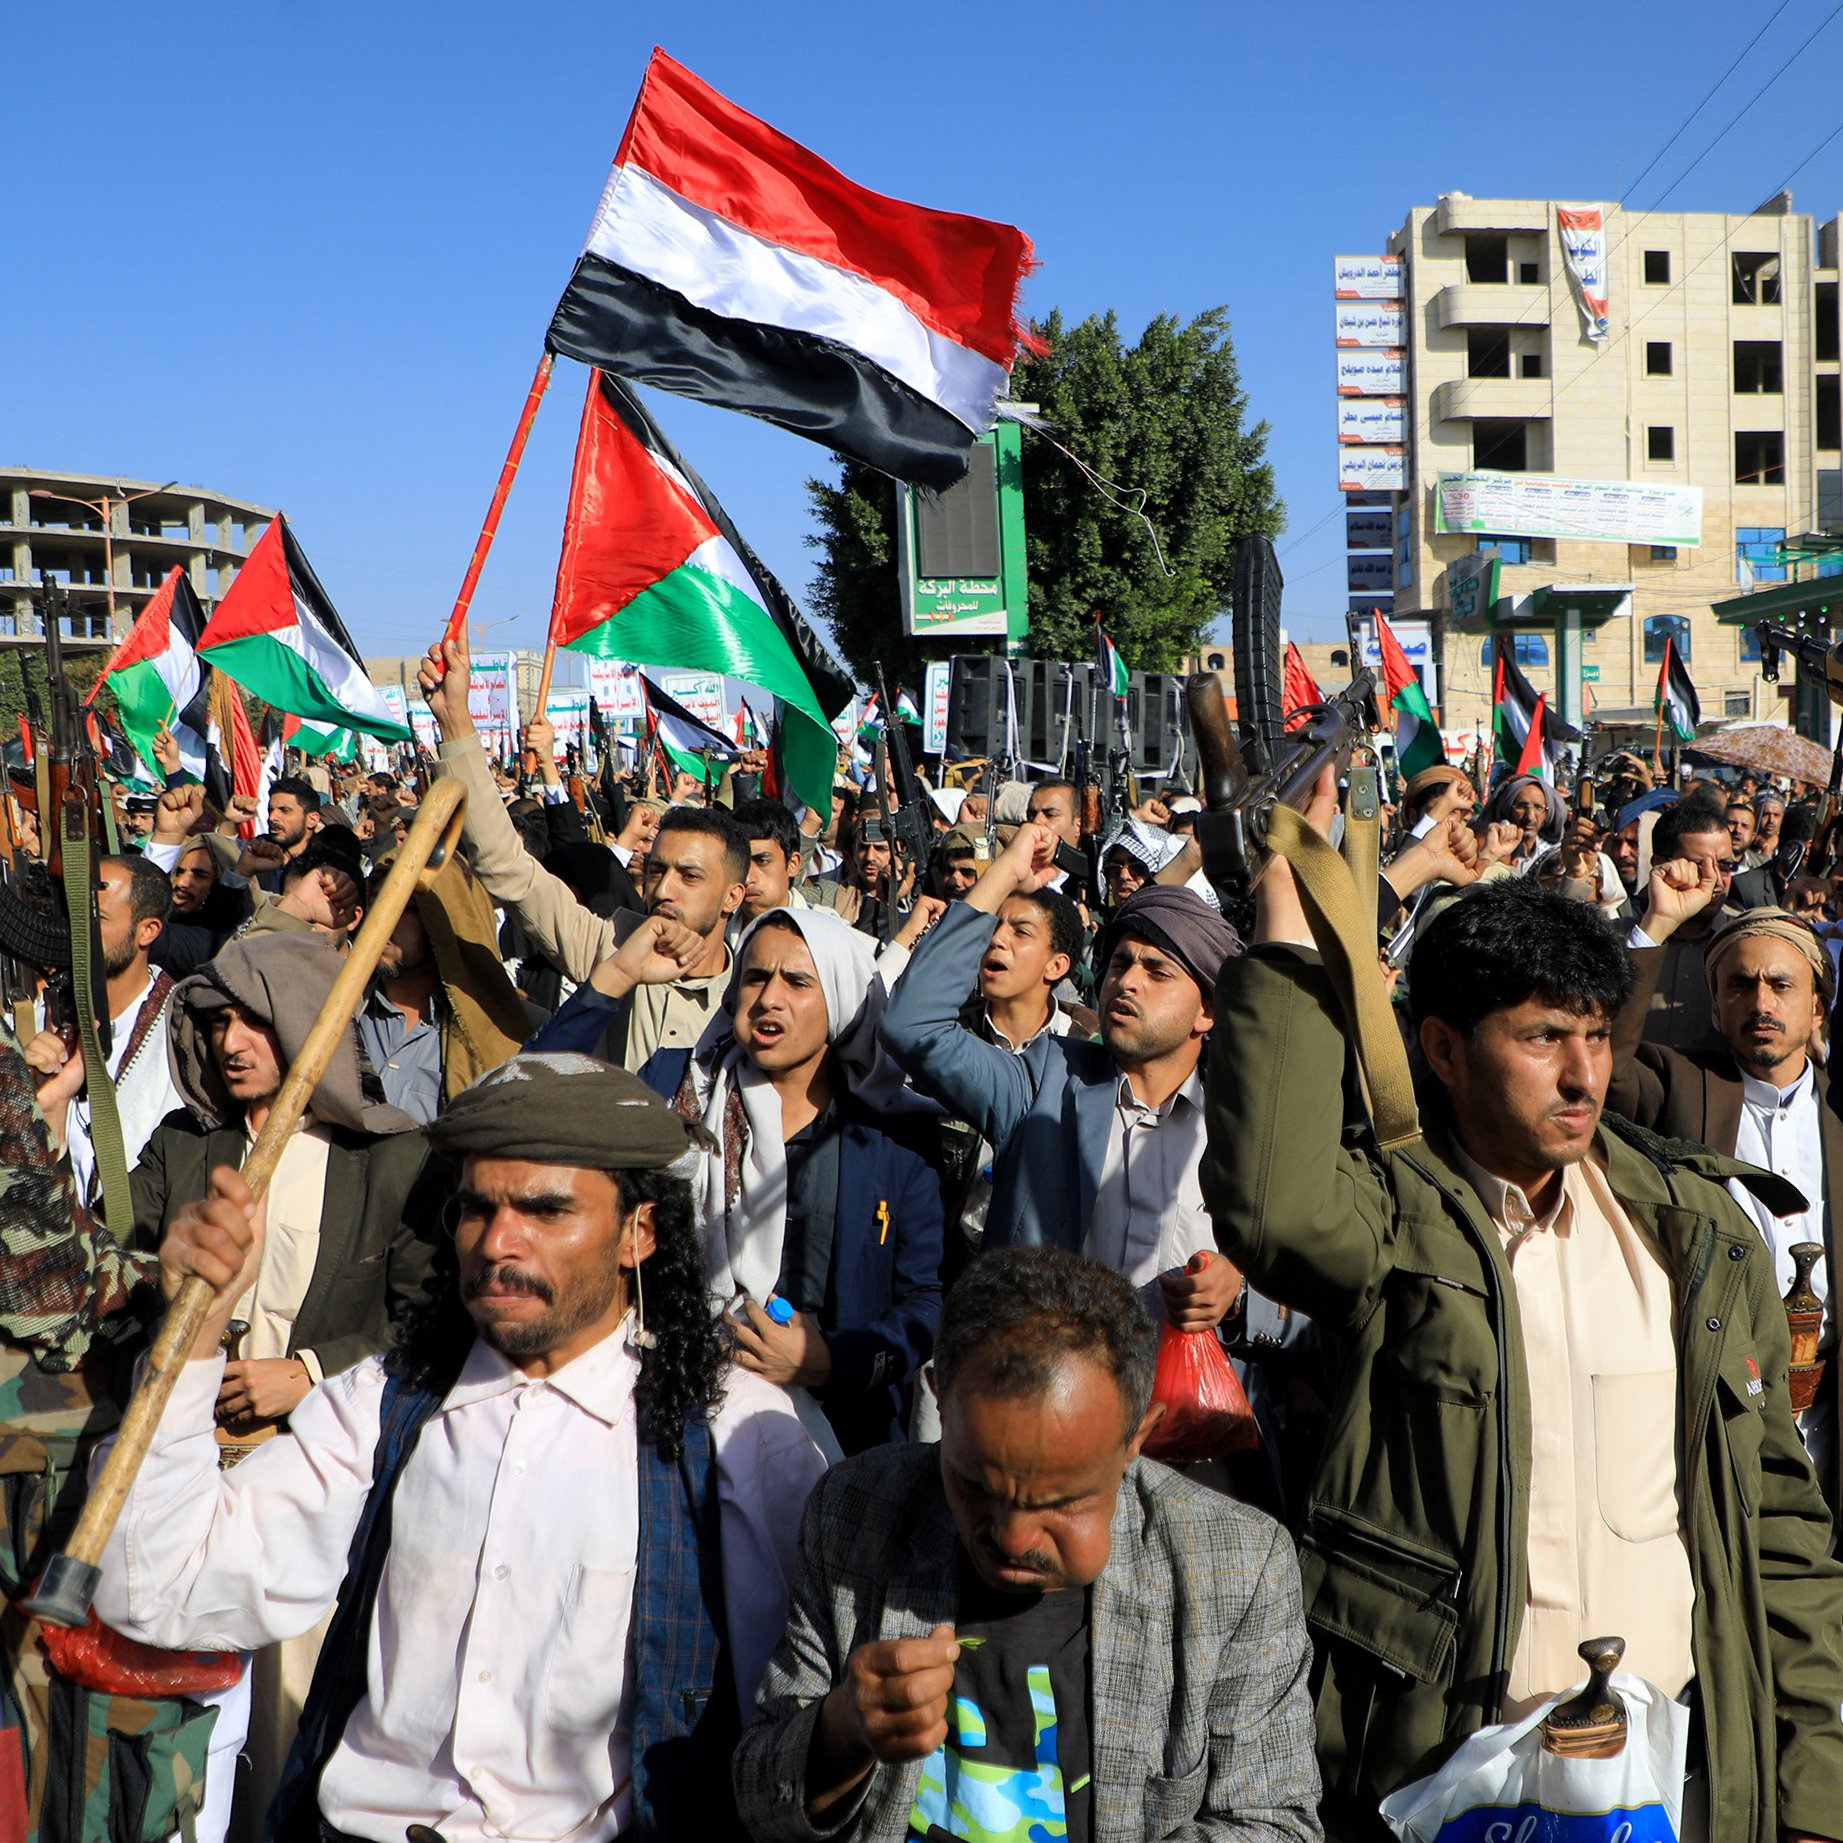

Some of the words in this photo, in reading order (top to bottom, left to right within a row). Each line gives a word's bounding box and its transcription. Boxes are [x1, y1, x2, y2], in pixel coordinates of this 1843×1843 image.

[918, 579, 956, 599] البركة
[959, 579, 998, 595] محطة
[936, 600, 978, 613] للمحروقات
